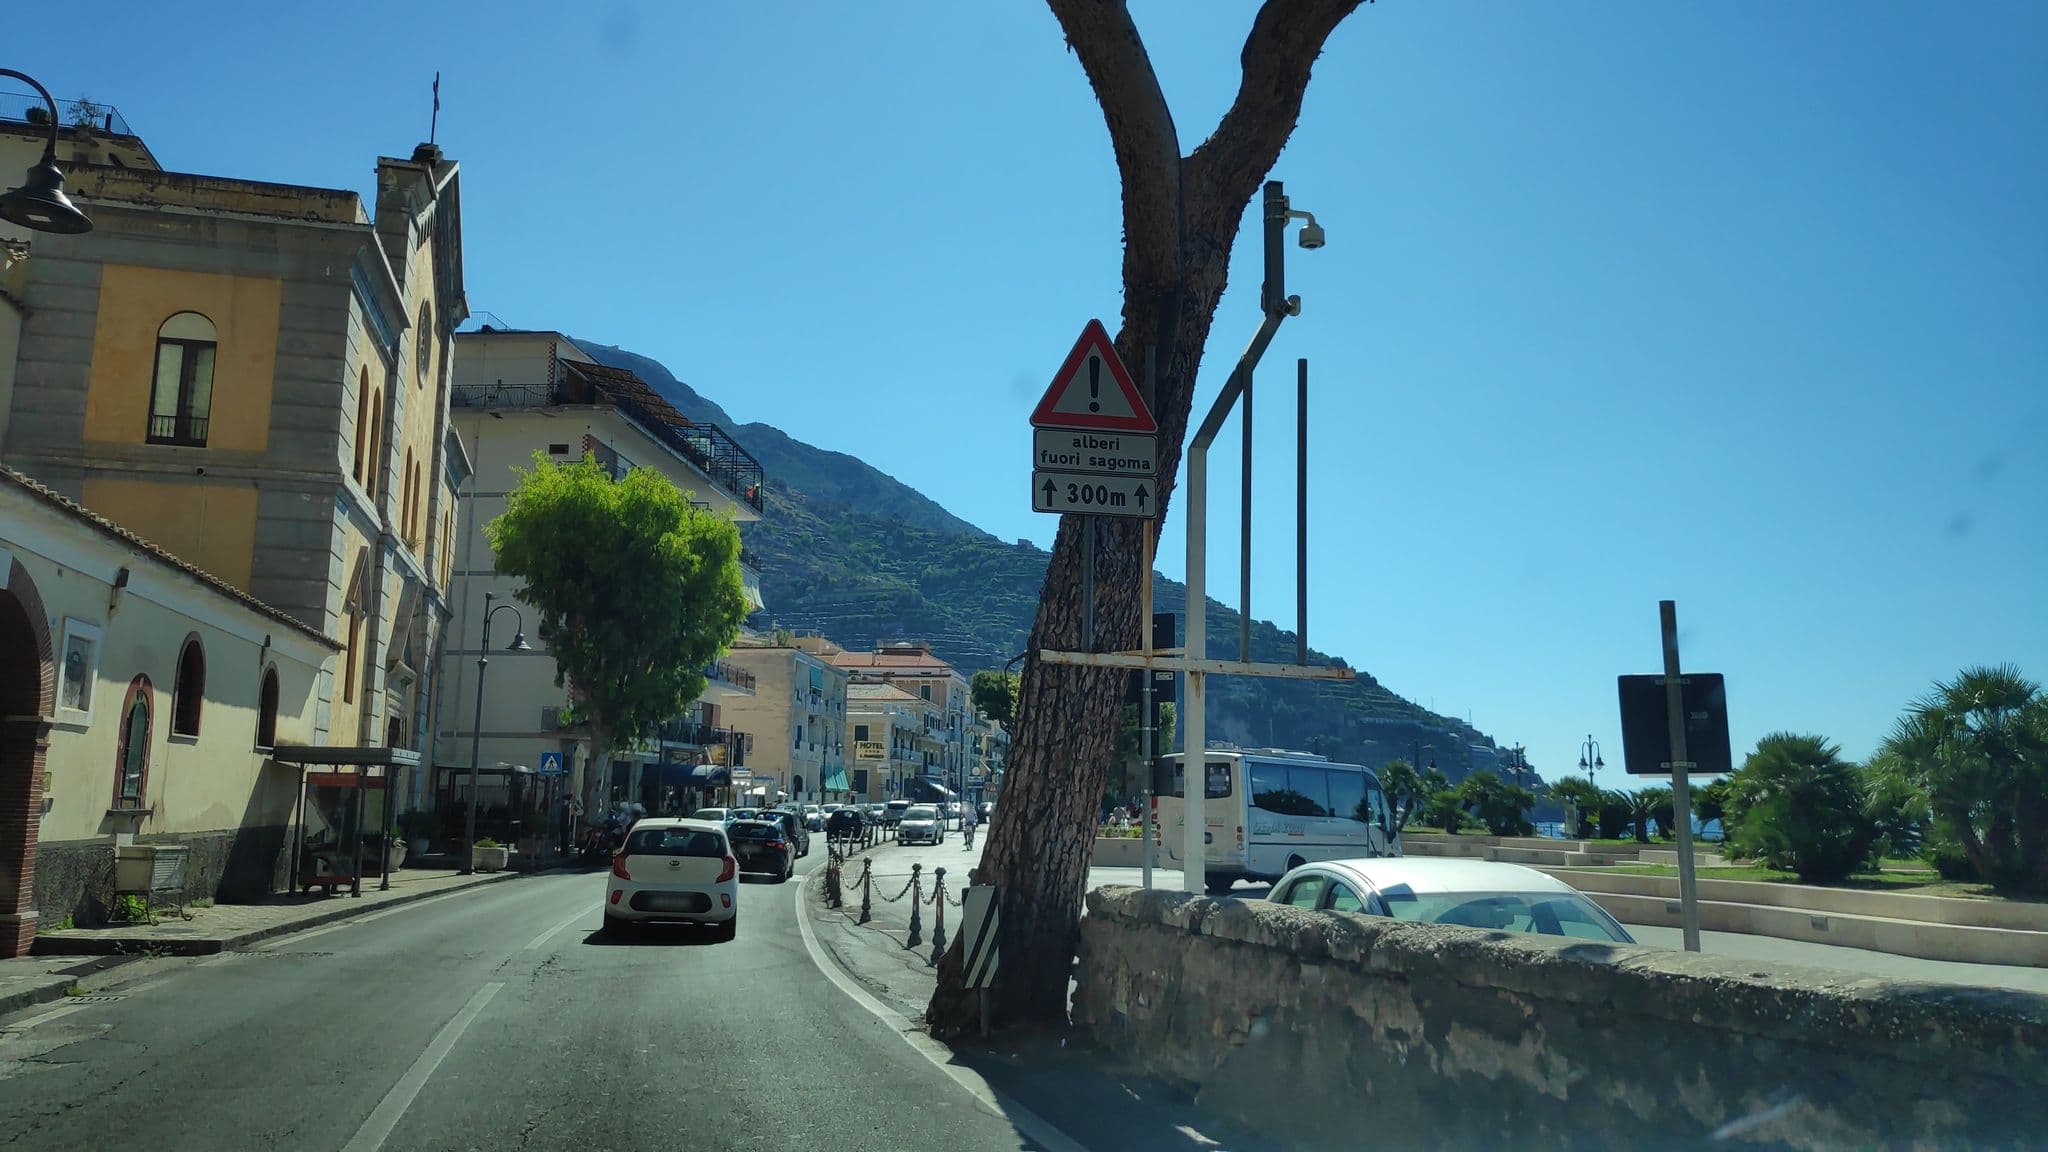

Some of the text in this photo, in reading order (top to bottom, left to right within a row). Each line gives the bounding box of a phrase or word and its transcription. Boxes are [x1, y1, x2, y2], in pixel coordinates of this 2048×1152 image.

[1072, 435, 1120, 450] alberi
[1040, 450, 1151, 470] fuori sagoma
[1067, 483, 1126, 506] 300m
